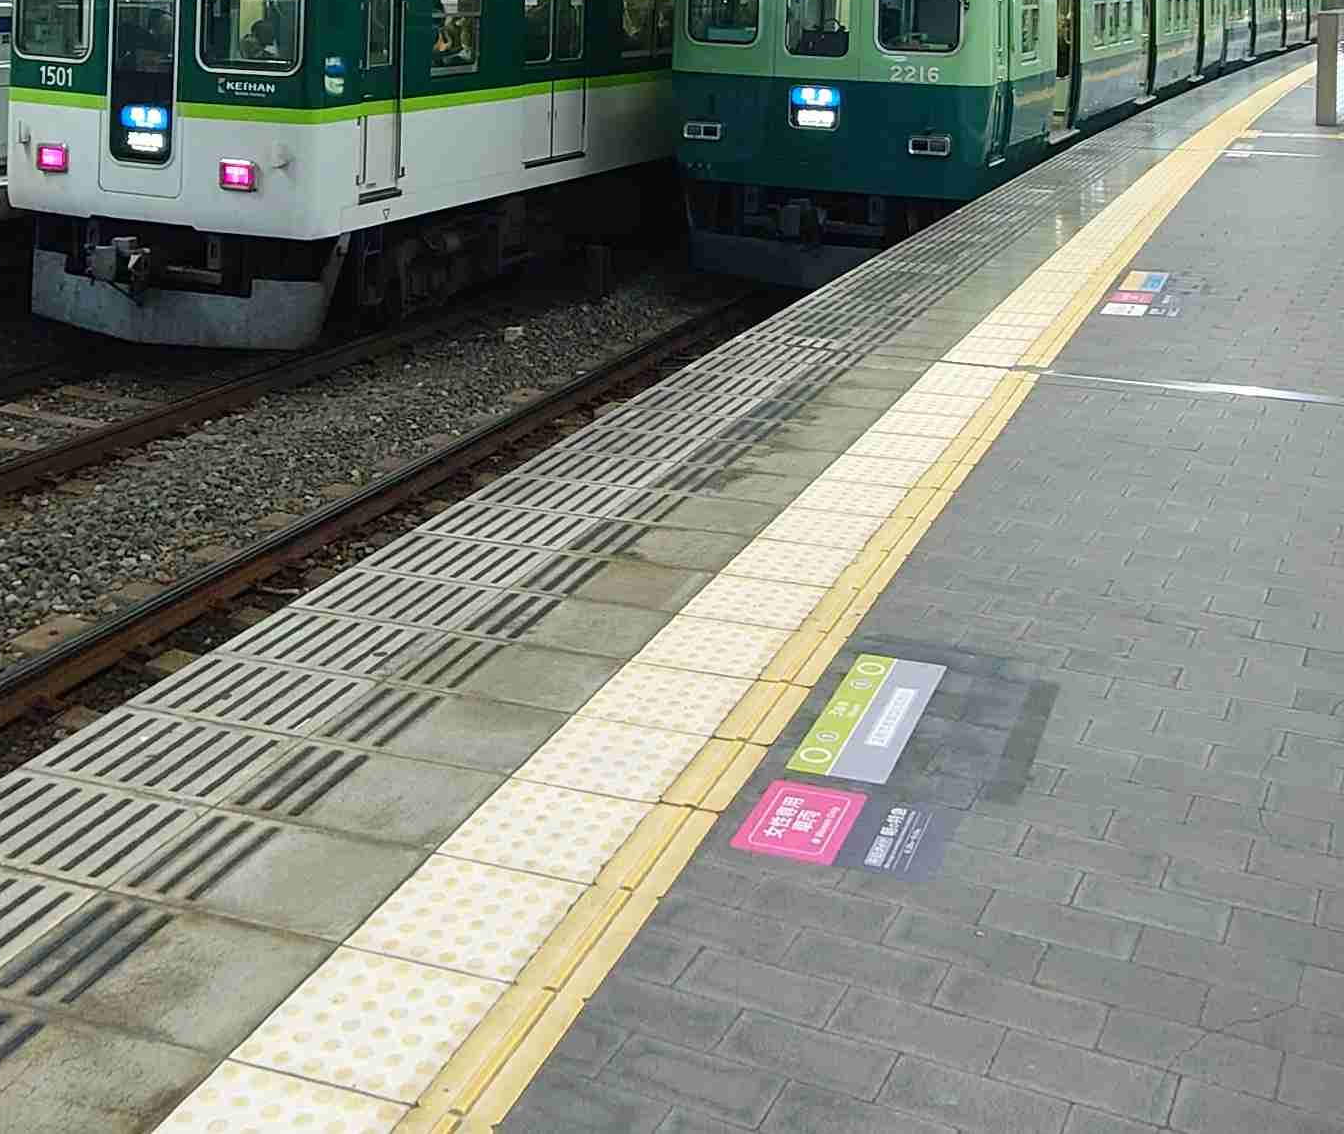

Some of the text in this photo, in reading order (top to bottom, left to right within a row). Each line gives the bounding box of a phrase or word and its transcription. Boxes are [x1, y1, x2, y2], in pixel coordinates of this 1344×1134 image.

[39, 65, 74, 88] 1501
[889, 65, 940, 83] 2216
[225, 79, 276, 94] KEIHAN
[763, 795, 805, 839] 女性専用
